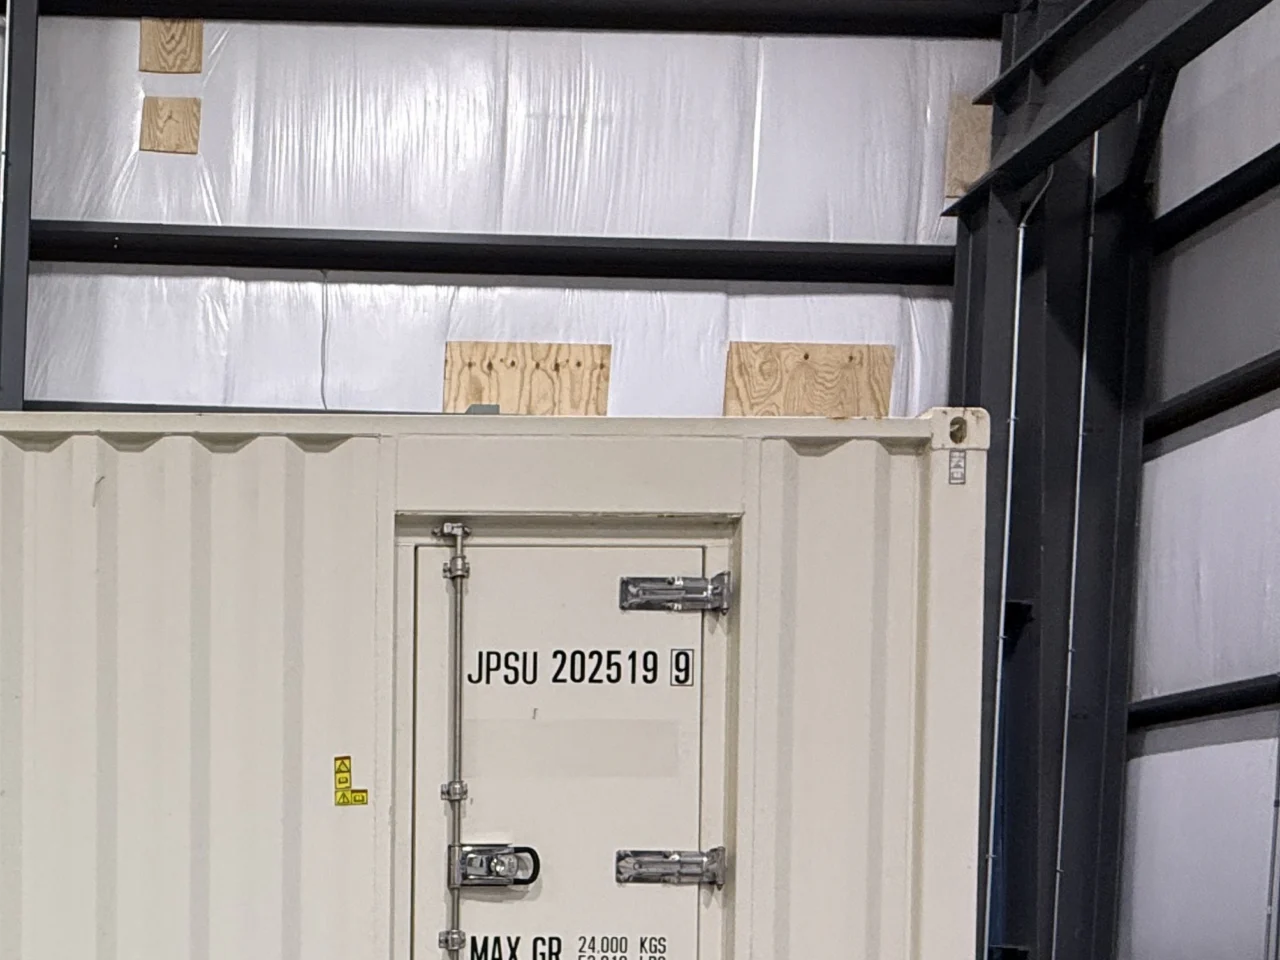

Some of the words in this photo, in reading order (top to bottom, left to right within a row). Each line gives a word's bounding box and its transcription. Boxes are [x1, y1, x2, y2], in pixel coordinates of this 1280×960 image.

[467, 650, 538, 684] JPSU
[551, 650, 658, 684] 202519
[674, 650, 690, 684] 9
[578, 936, 628, 954] 24.000
[639, 937, 667, 954] KGS
